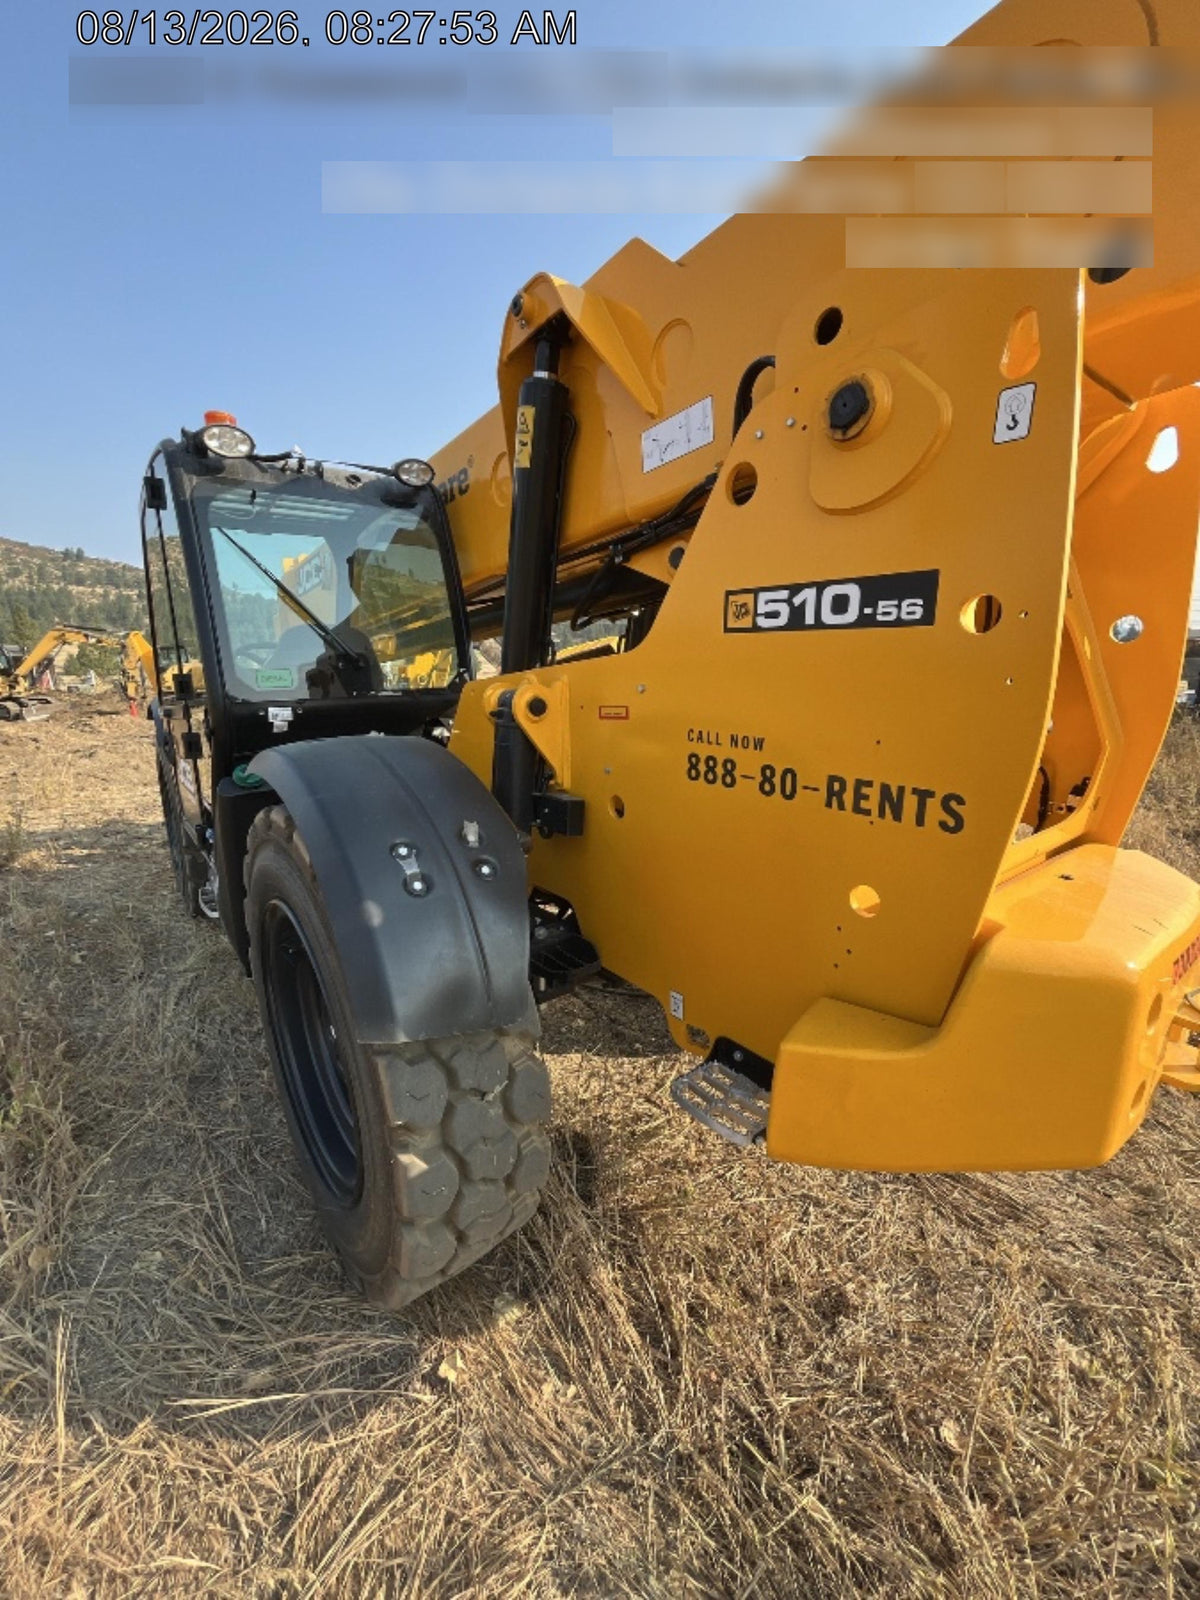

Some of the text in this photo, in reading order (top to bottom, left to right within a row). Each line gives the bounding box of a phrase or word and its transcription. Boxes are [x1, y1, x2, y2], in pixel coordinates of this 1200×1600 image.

[755, 582, 924, 628] 510-56
[687, 728, 765, 751] CALL NOW
[686, 752, 967, 835] 888-80-RENTS
